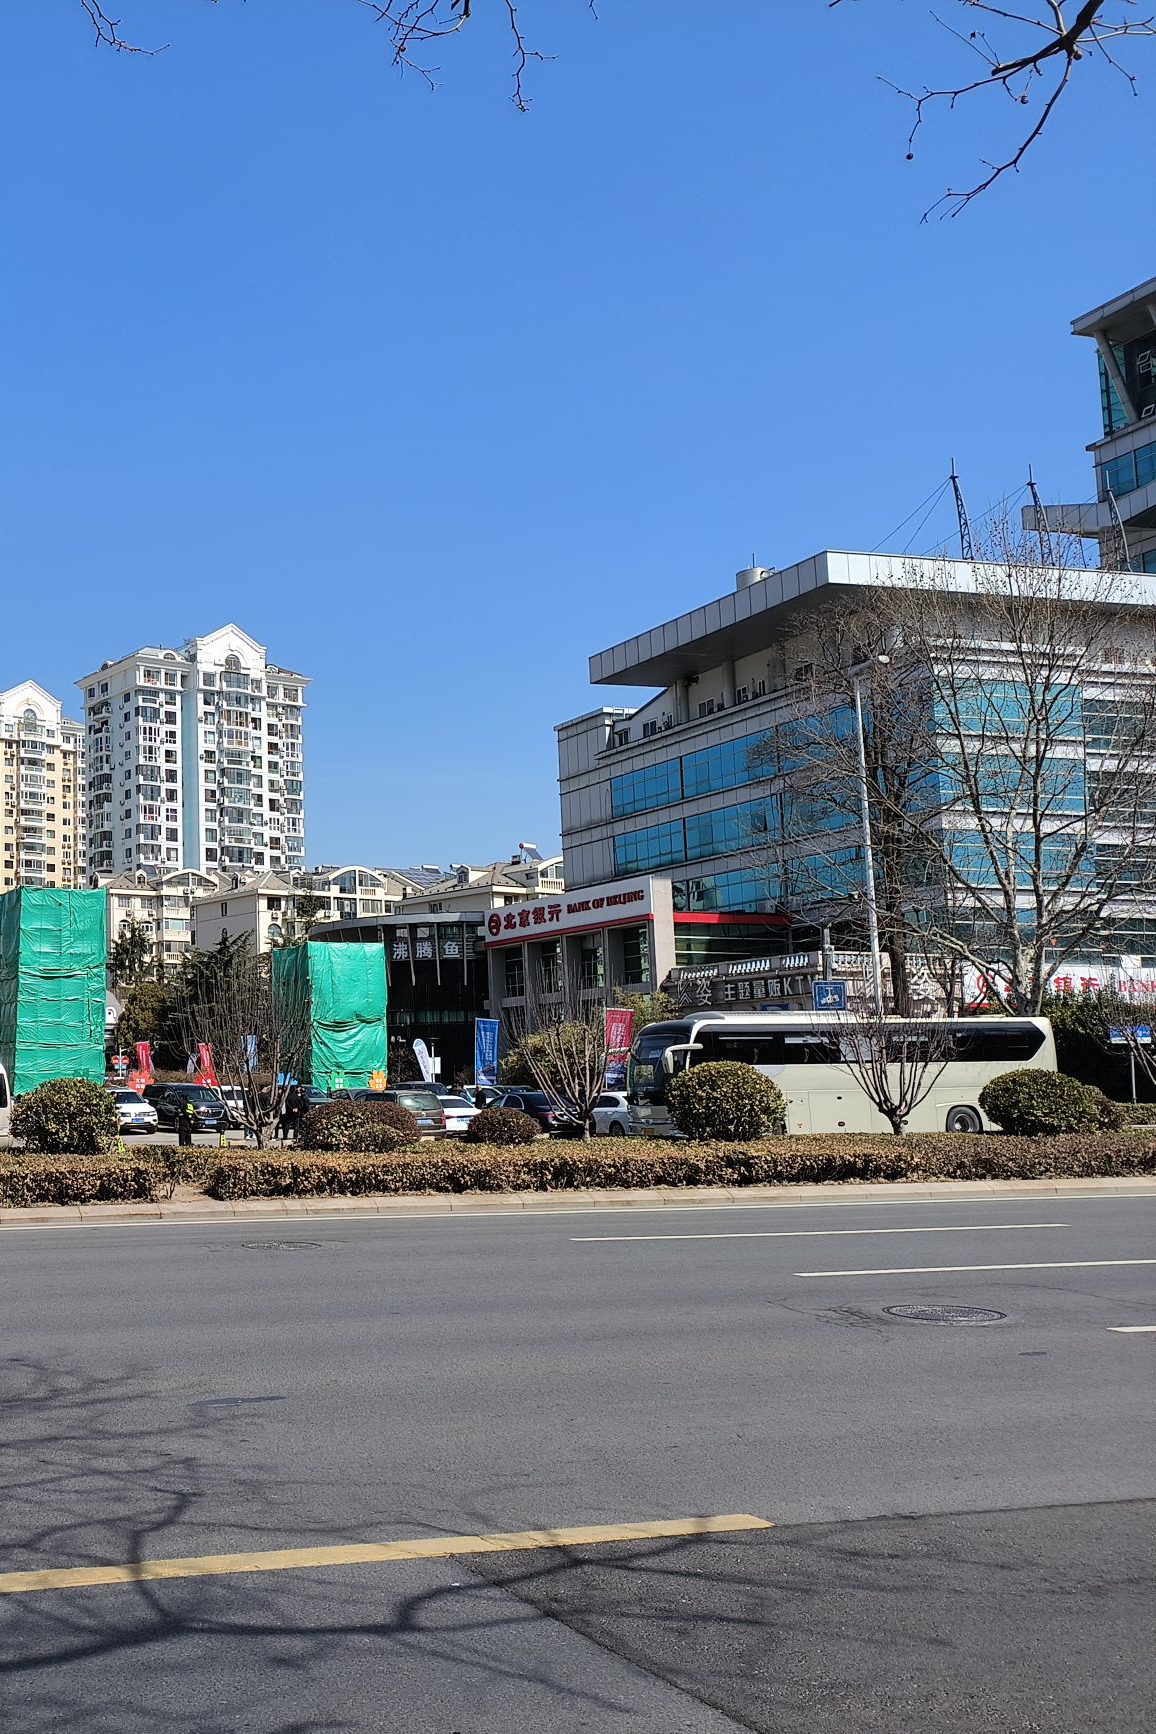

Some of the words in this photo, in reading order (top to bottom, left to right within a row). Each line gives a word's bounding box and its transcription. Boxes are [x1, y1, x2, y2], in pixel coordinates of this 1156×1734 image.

[504, 904, 562, 930] 北京银行
[567, 903, 592, 914] BANK
[592, 899, 605, 910] OF
[606, 890, 644, 907] BEIJING
[393, 941, 460, 959] 沸腾鱼
